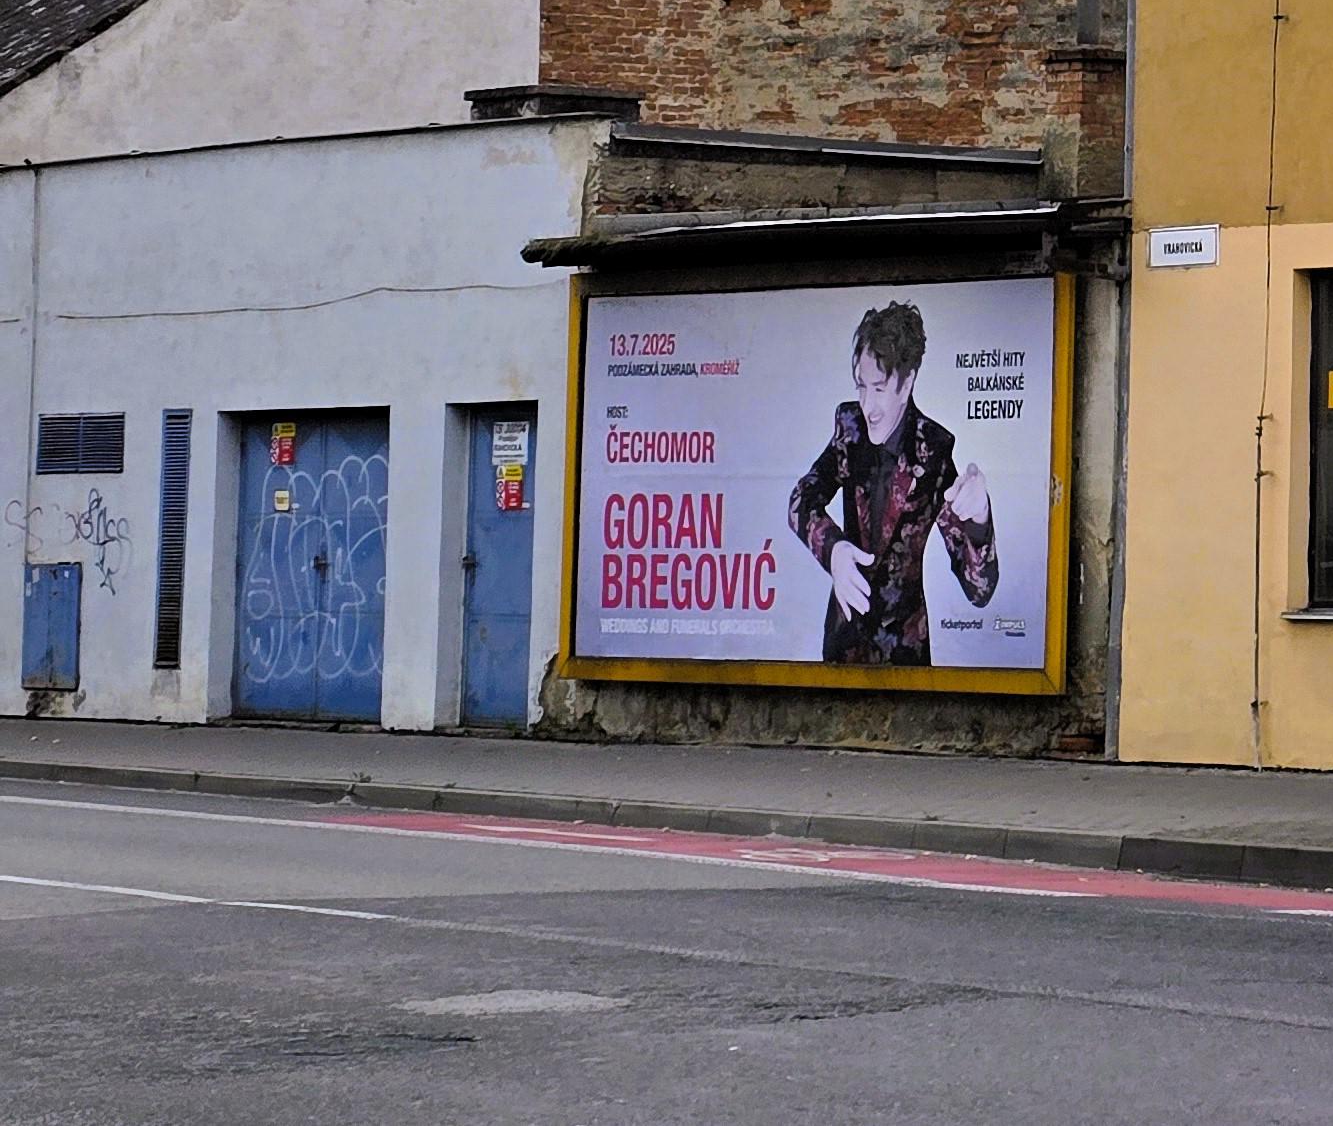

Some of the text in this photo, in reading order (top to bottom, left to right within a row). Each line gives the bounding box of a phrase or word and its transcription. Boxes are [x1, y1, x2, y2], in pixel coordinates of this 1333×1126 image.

[610, 333, 676, 356] 13.7.2025
[956, 349, 1025, 368] NEJVĚTŠÍ HITY
[608, 361, 659, 376] PODZÁMECKÁ
[661, 362, 699, 378] ZAHRADA,
[968, 372, 1025, 391] BALKÁNSKÉ
[606, 406, 628, 419] HOST:
[968, 399, 1023, 419] LEGENDY
[606, 424, 715, 464] ČECHOMOR
[603, 493, 724, 550] GORAN
[602, 538, 777, 611] BREGOVIĆ
